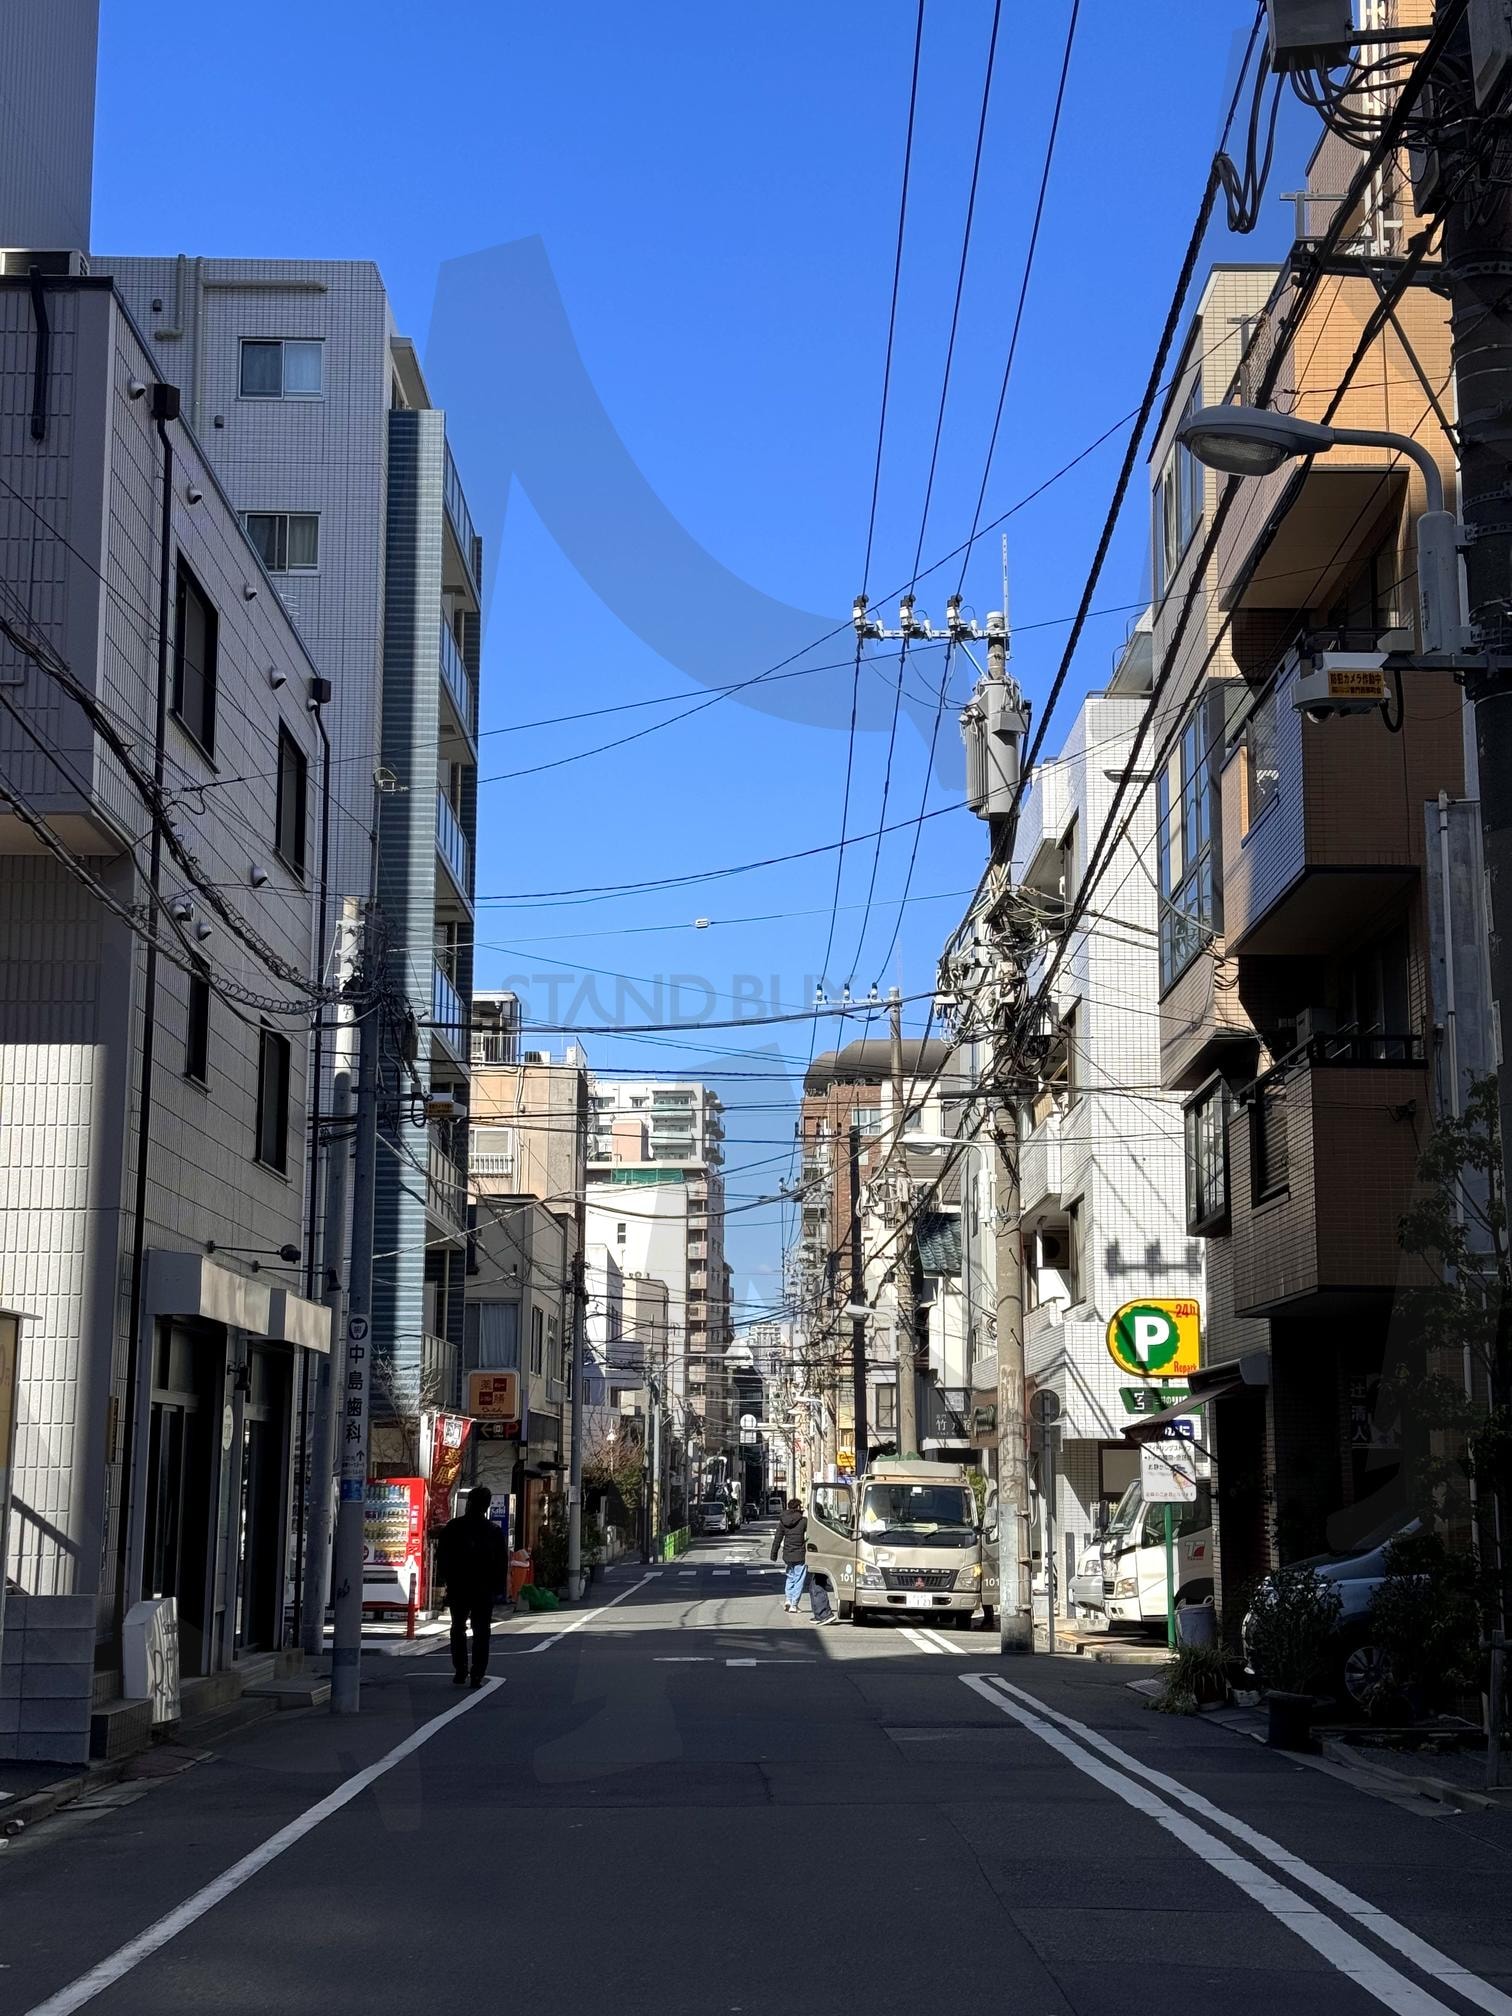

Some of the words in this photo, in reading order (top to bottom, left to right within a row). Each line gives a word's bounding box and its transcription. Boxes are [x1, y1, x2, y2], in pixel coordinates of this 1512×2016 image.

[1330, 673, 1382, 684] 防犯カメラ作動中
[1175, 1304, 1196, 1318] 24h
[1134, 1316, 1170, 1362] P
[1173, 1361, 1197, 1374] Repark
[345, 1344, 364, 1444] 中島歯科
[840, 1573, 854, 1583] 101
[984, 1578, 1001, 1587] 101
